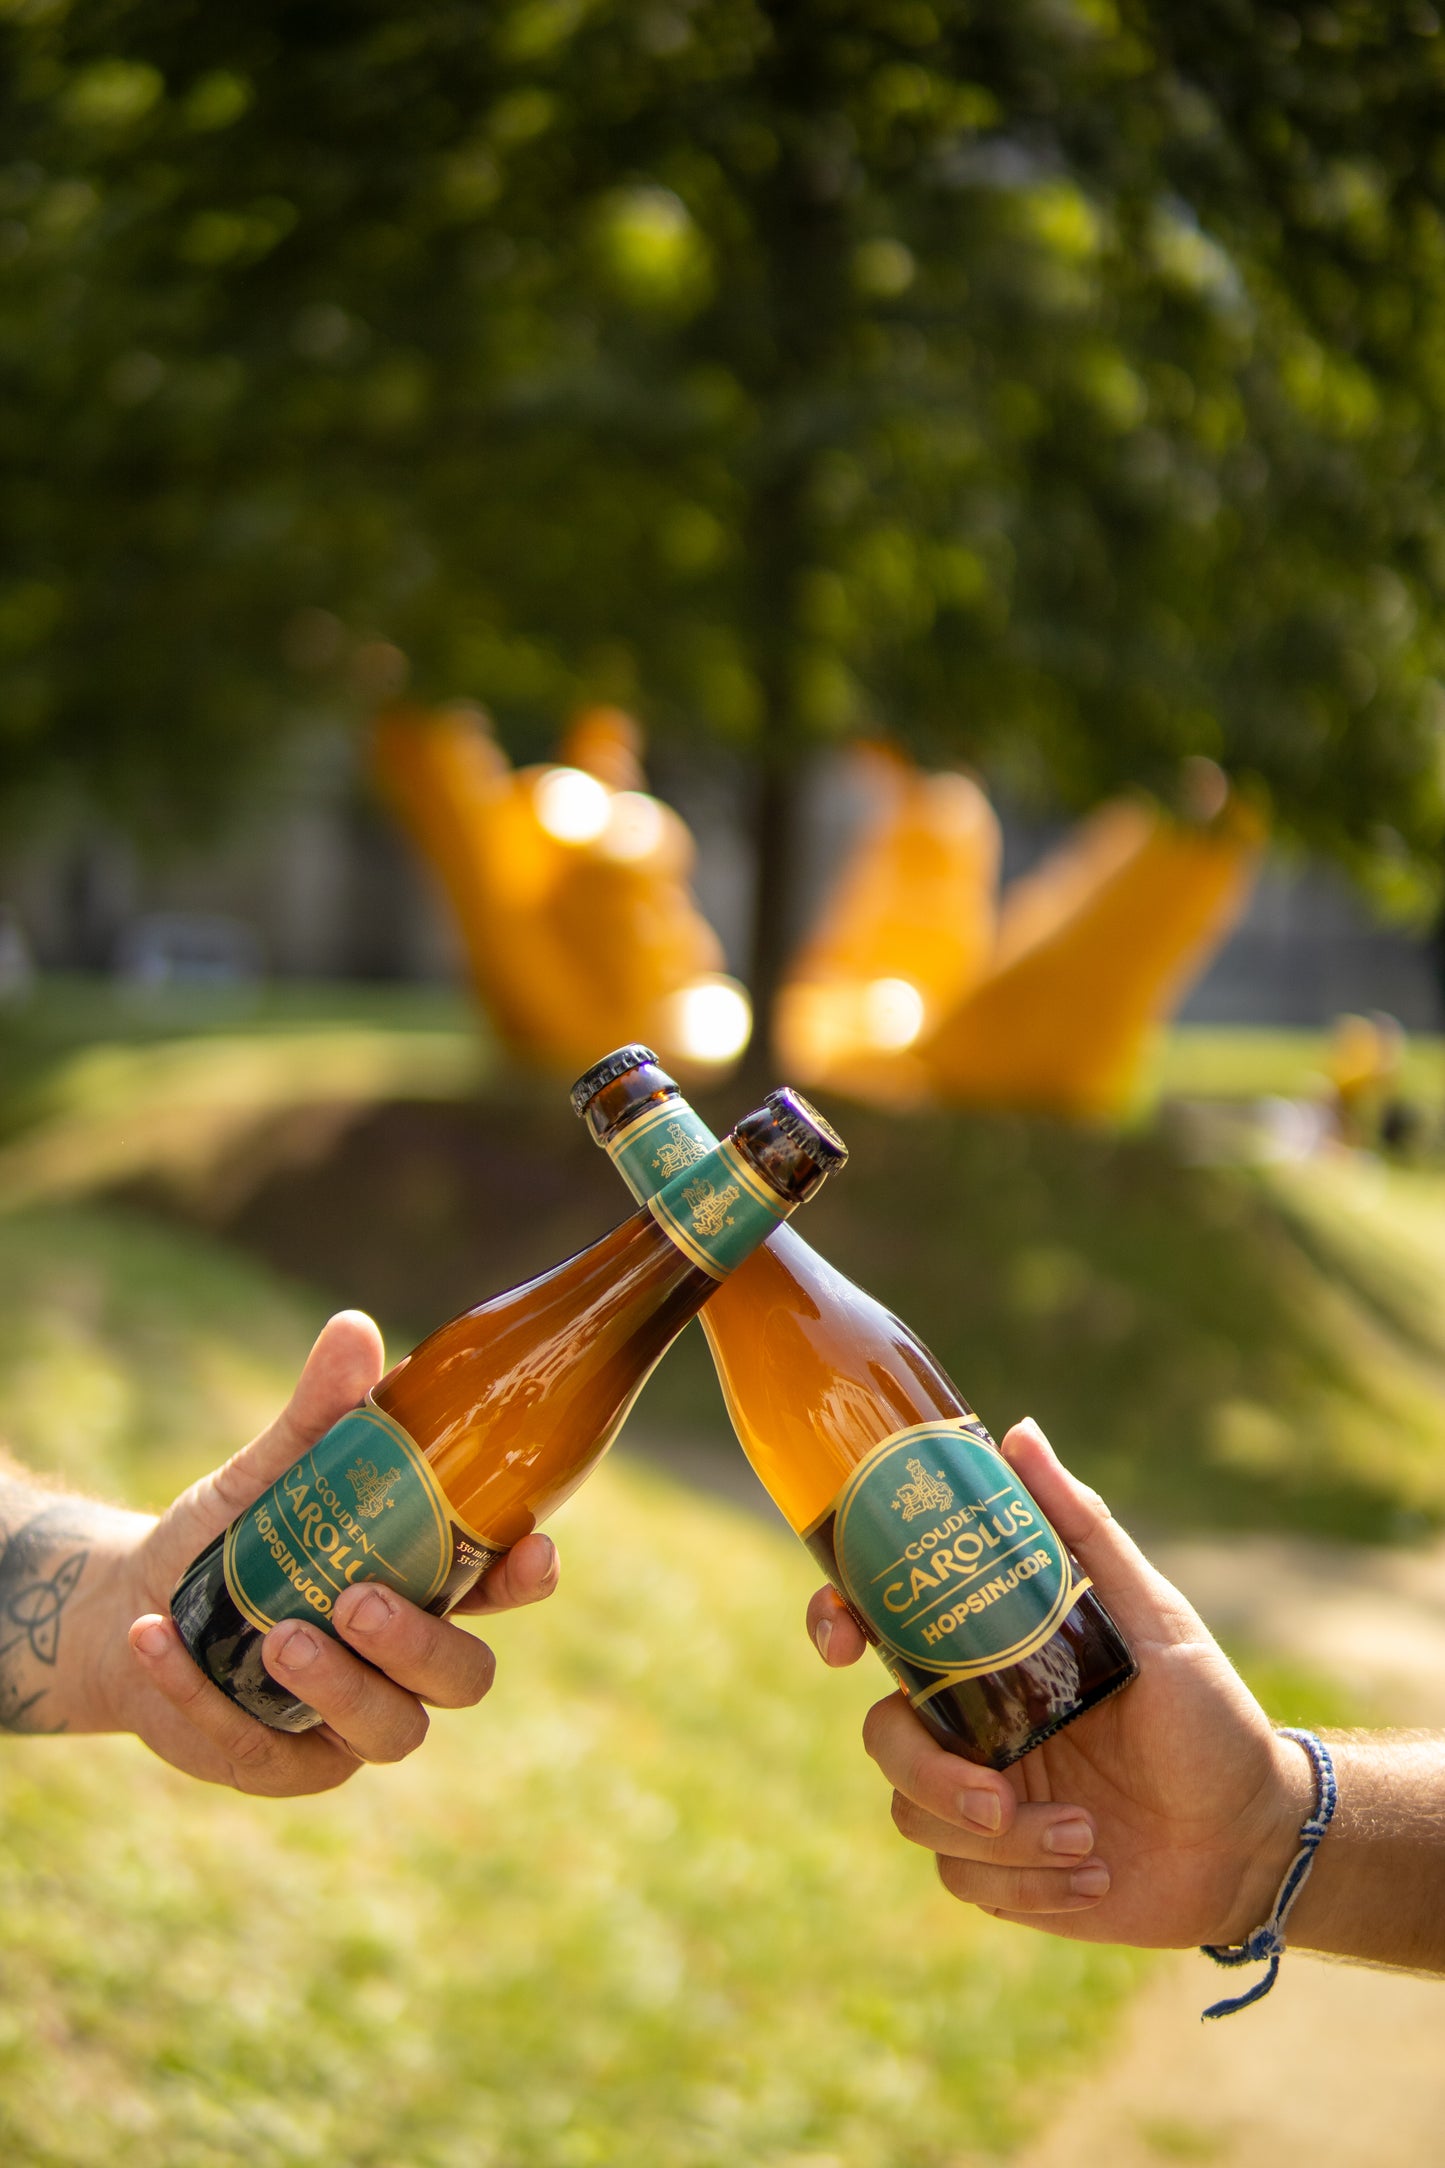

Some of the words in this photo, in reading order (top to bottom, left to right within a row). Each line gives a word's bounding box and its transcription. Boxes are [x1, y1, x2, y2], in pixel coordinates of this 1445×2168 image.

[284, 1464, 377, 1583] CAROLU
[315, 1476, 375, 1554] GOUDEN
[457, 1541, 474, 1553] 330
[883, 1501, 1033, 1613] CAROLUS
[905, 1499, 988, 1561] GOUDEN
[921, 1549, 1052, 1646] HOPSINJOOR
